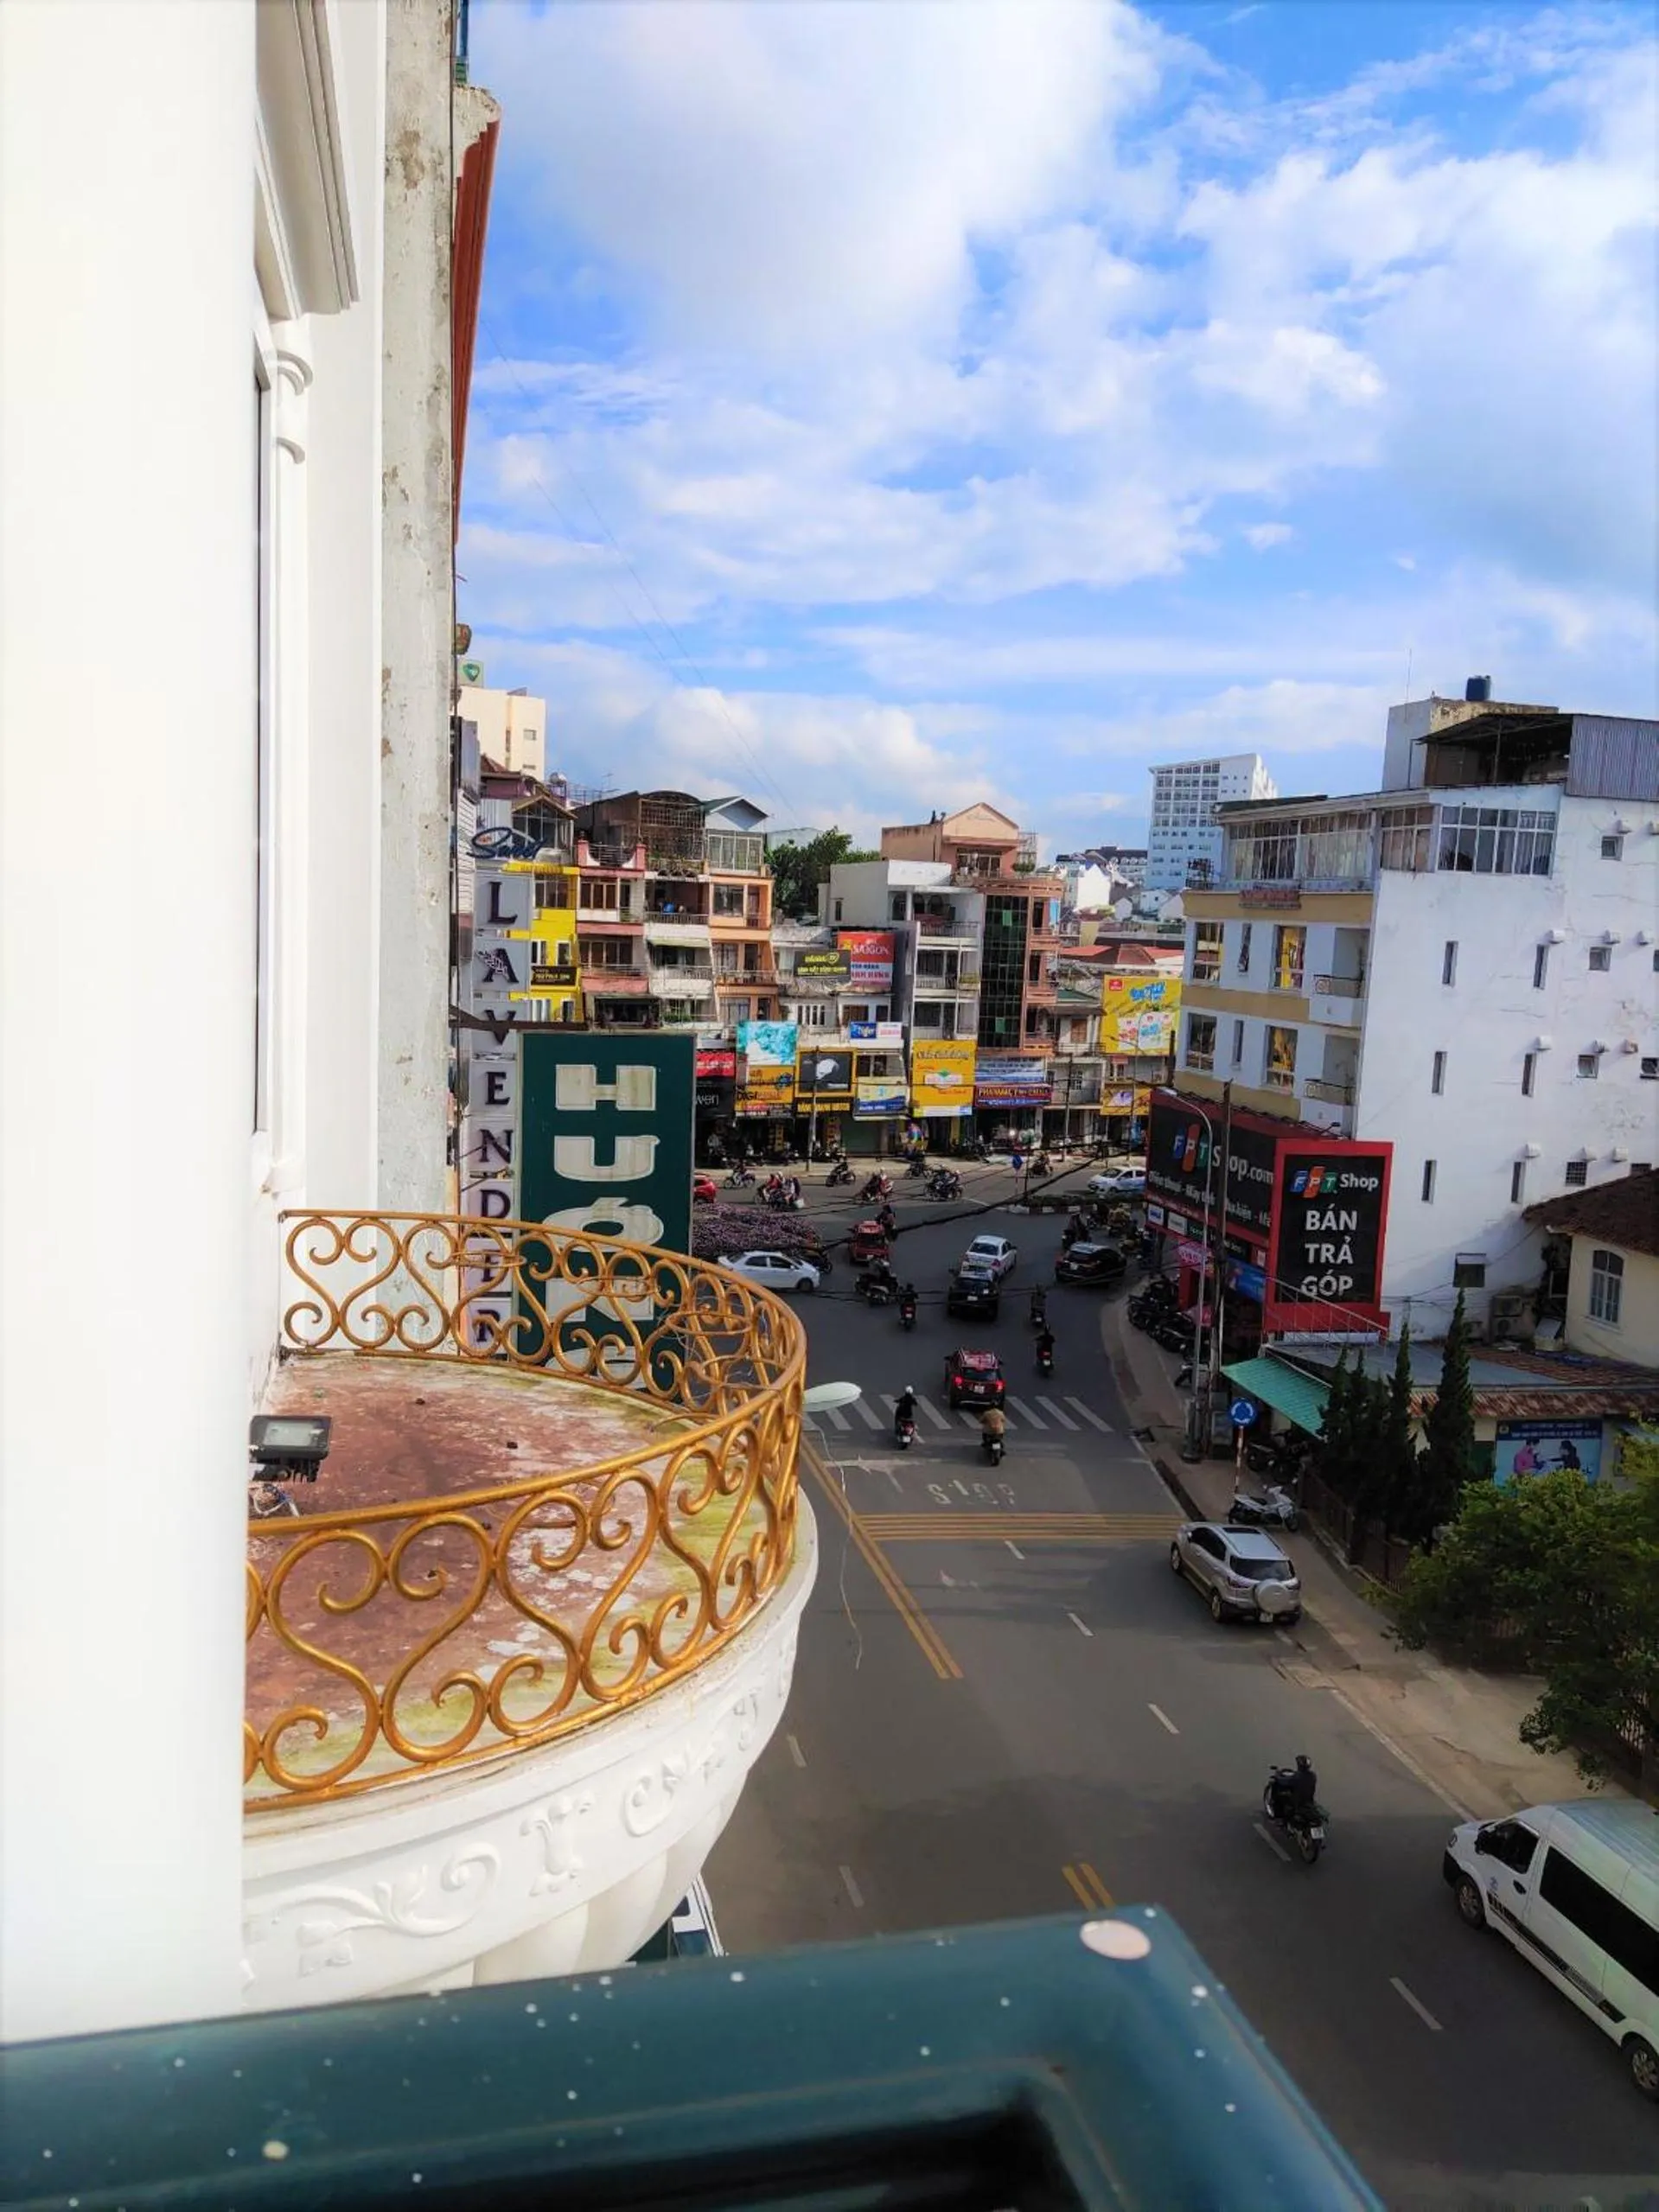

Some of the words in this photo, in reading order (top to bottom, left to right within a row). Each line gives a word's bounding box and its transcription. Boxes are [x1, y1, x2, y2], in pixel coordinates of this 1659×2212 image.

[1212, 1144, 1273, 1184] Sop.com
[1291, 1170, 1337, 1195] FPT
[1340, 1172, 1379, 1191] Shop
[1305, 1203, 1357, 1231] BÁN
[1305, 1235, 1354, 1265] TRẢ
[1300, 1269, 1354, 1297] GÓP
